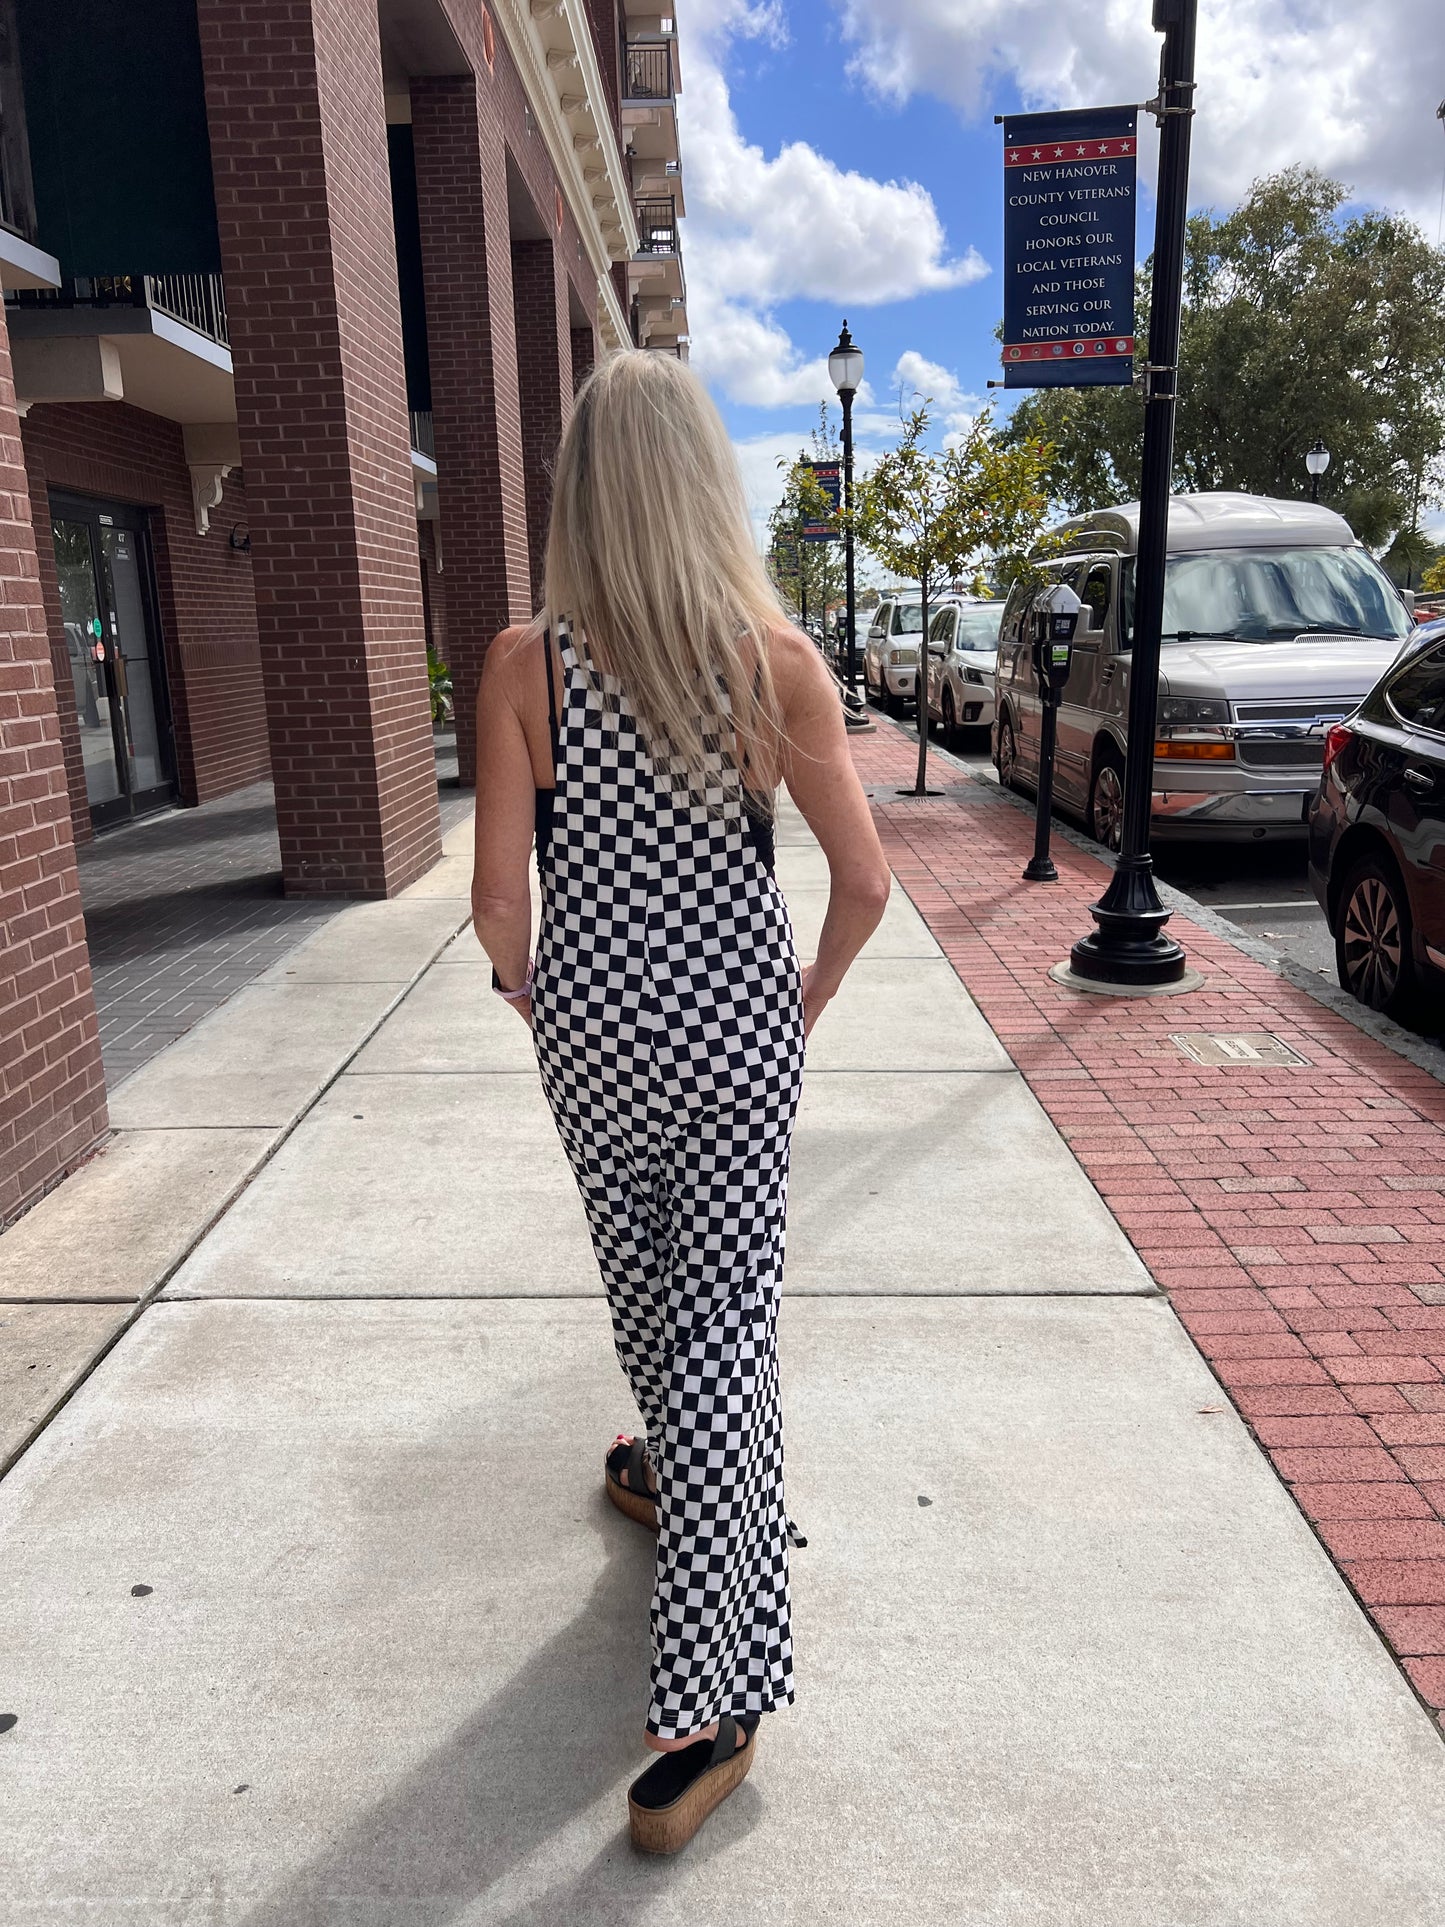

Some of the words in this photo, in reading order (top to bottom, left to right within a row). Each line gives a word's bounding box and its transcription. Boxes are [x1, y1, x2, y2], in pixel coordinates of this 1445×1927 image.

[1022, 170, 1051, 183] NEW
[1055, 164, 1118, 179] HANOVER
[1009, 191, 1064, 207] COUNTY
[1067, 185, 1130, 201] VETERANS
[1039, 211, 1099, 227] COUNCIL
[1025, 236, 1081, 250] HONORS
[1085, 232, 1114, 245] OUR
[1016, 260, 1057, 273] LOCAL
[1060, 254, 1122, 269] VETERANS
[1032, 282, 1061, 294] AND
[1063, 277, 1106, 292] THOSE
[1026, 302, 1079, 316] SERVING
[1083, 299, 1112, 312] OUR
[1022, 325, 1069, 338] NATION
[1072, 320, 1115, 335] TODAY.
